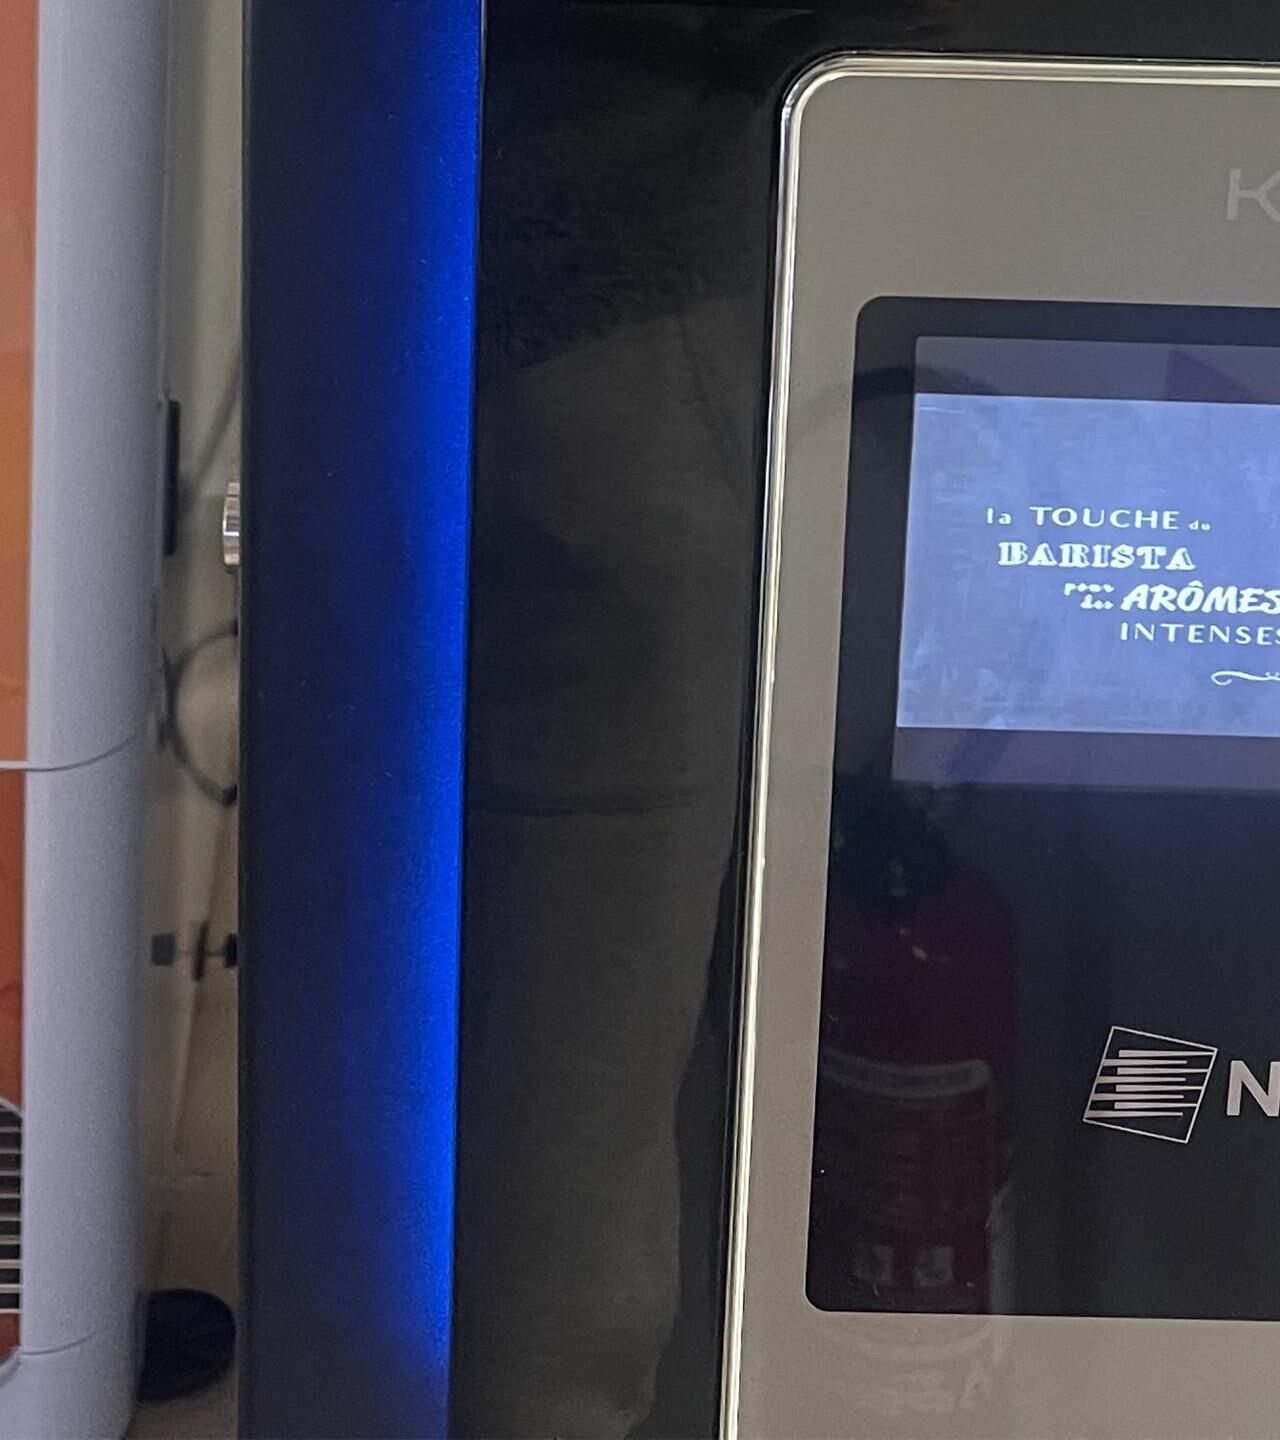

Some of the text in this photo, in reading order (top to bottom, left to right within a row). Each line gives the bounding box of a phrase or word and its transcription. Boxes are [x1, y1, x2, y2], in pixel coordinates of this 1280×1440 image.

[986, 506, 1210, 531] la TOUCHE du
[998, 541, 1197, 571] BARISTA
